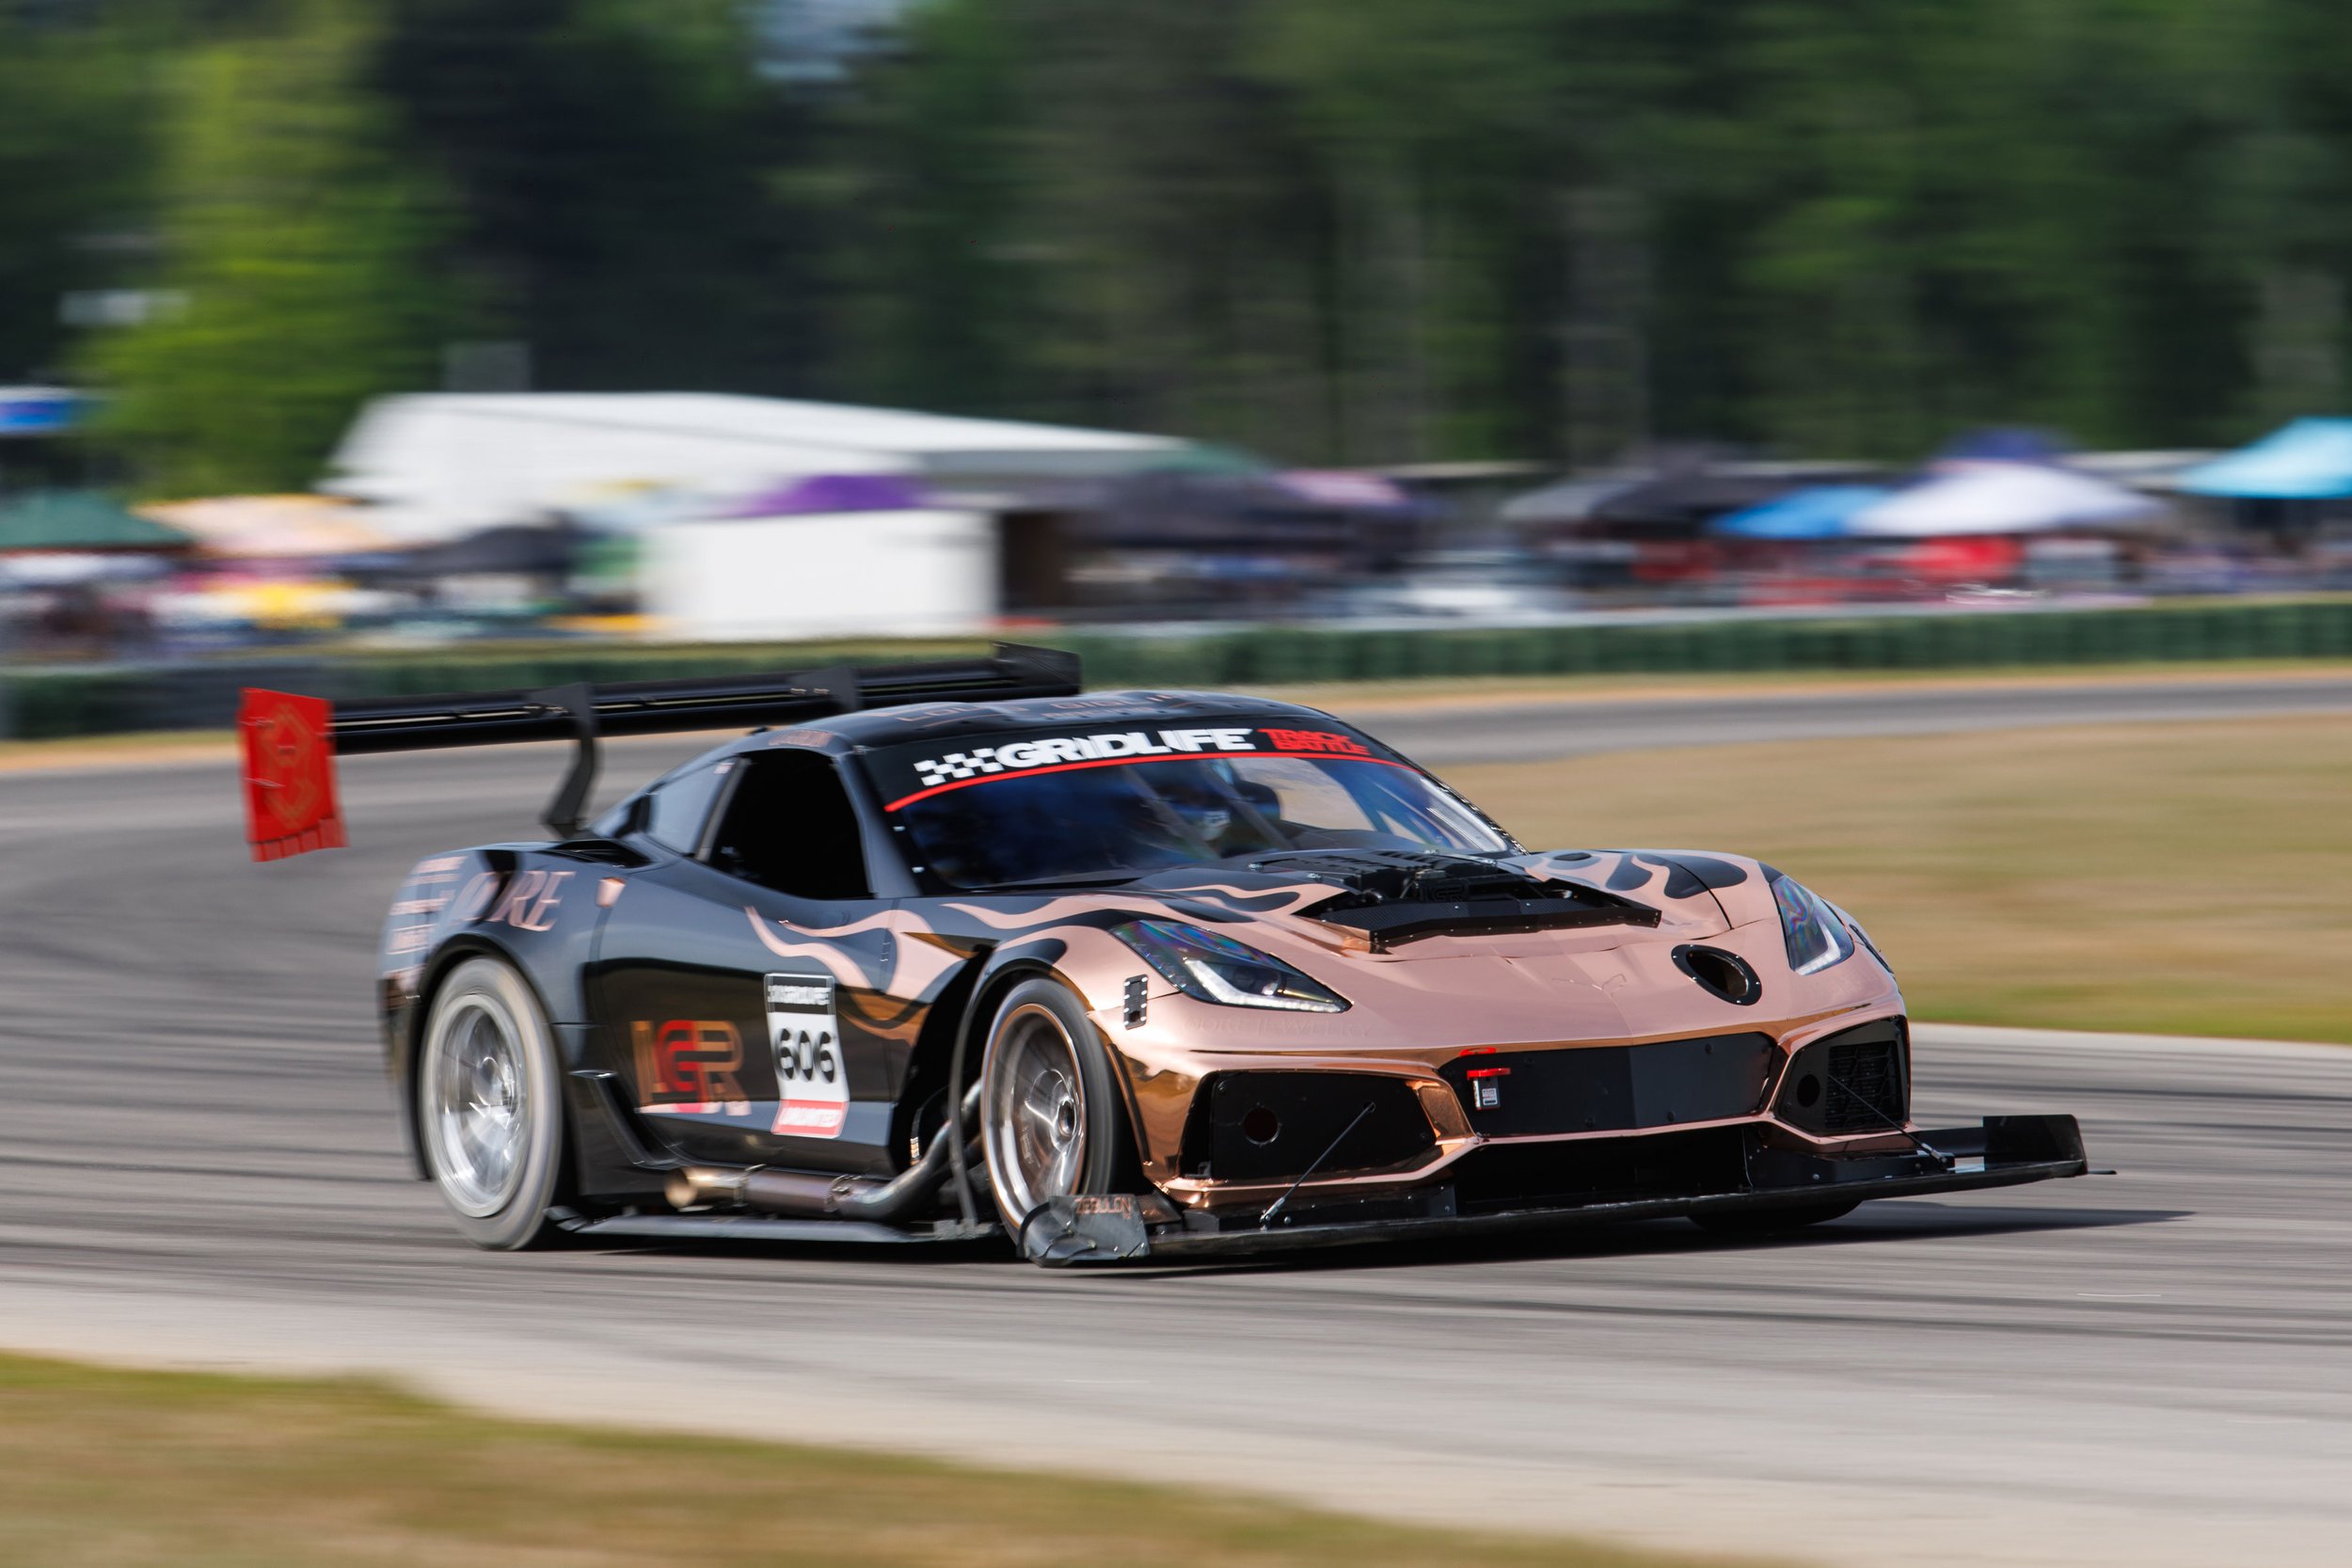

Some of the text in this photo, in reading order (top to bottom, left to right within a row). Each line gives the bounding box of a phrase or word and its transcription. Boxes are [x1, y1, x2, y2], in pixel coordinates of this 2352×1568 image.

[994, 727, 1257, 768] GRIDLIFE
[1256, 728, 1353, 742] TRACK
[1272, 736, 1373, 756] BATTLE
[774, 1026, 836, 1085] 606
